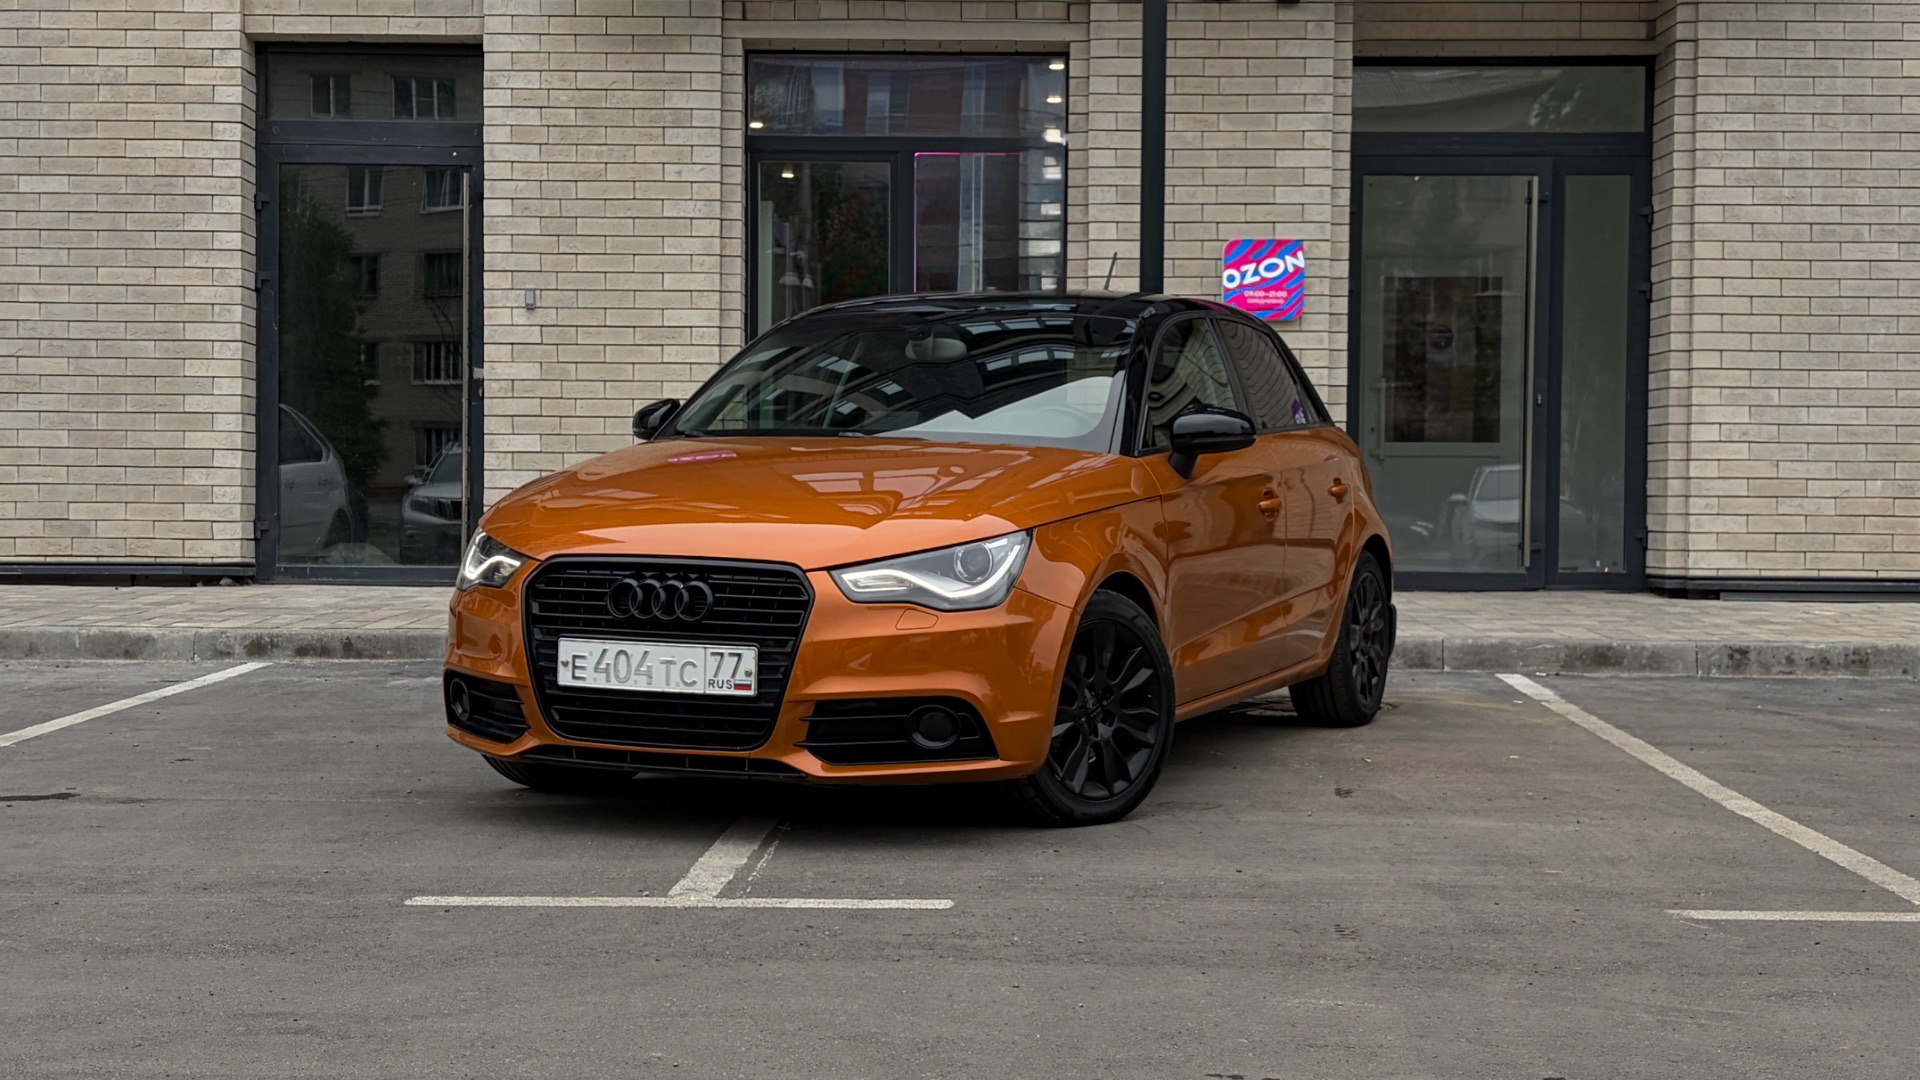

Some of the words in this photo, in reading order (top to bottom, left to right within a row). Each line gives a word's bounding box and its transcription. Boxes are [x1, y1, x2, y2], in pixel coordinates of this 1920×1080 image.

[1223, 251, 1305, 289] OZON
[710, 652, 743, 679] 77
[708, 679, 733, 689] RUS
